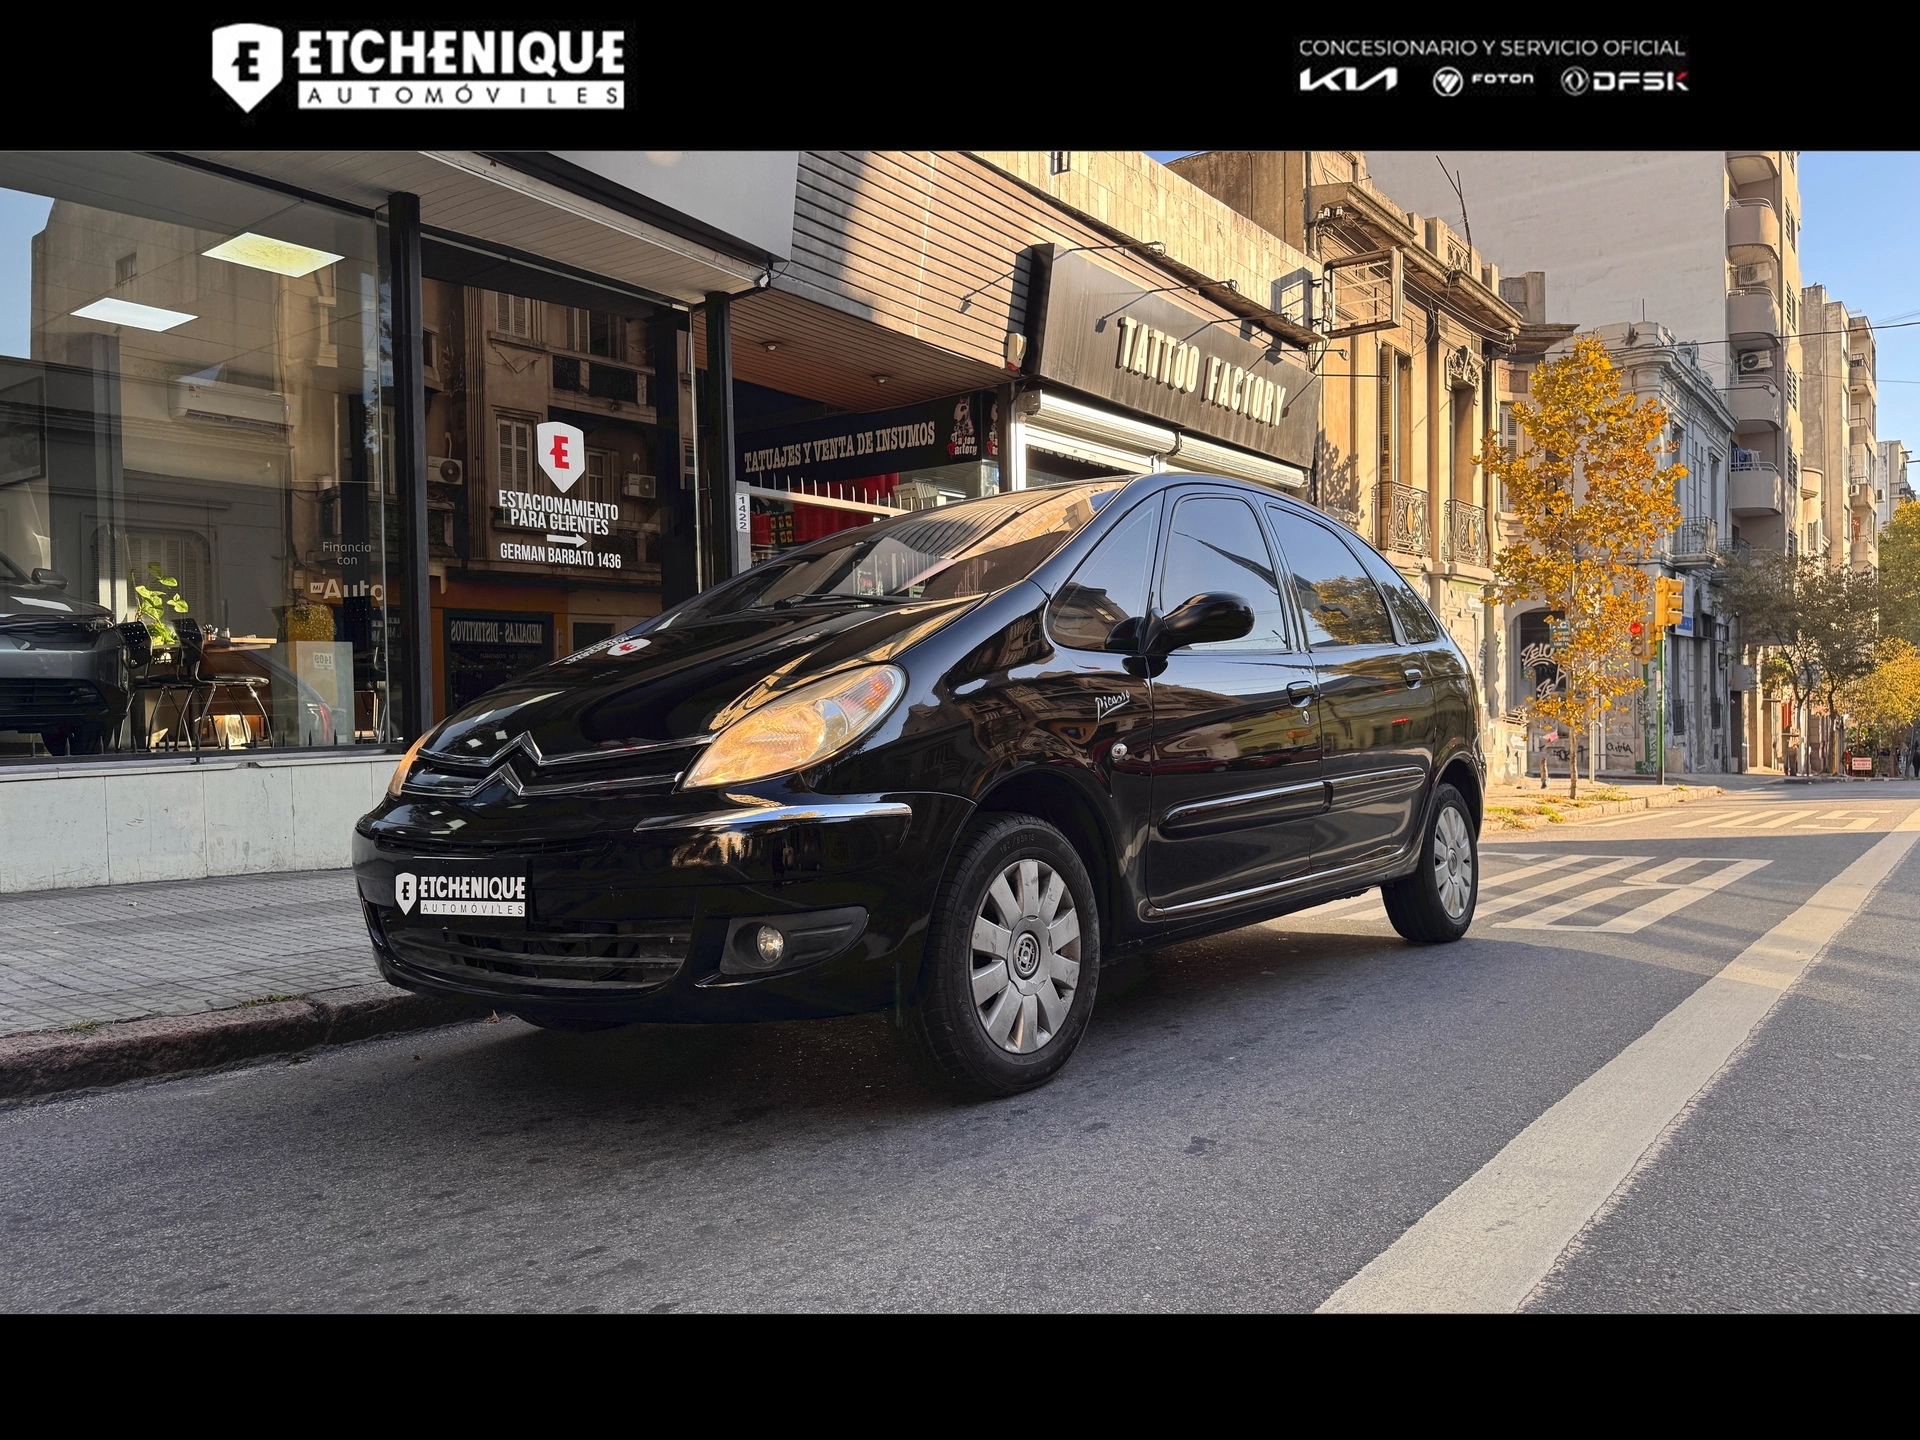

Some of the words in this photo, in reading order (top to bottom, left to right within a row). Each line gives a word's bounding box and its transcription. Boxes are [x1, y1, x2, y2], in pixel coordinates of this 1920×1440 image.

[1119, 316, 1200, 393] TATTOO
[1204, 356, 1287, 427] FACTORY
[744, 443, 801, 473] TATUAJES
[803, 442, 812, 464] Y
[813, 434, 855, 463] VENTA
[857, 431, 874, 455] DE
[875, 421, 936, 452] INSUMOS
[498, 489, 619, 521] ESTACIONAMIENTO
[738, 496, 748, 530] 1422
[510, 508, 547, 529] PARA
[549, 513, 609, 536] CLIENTES
[322, 541, 372, 553] Financia
[336, 556, 358, 565] con
[500, 542, 545, 562] GERMAN
[548, 547, 594, 567] BARBATO
[597, 552, 622, 569] 1436
[323, 578, 384, 601] Auto
[1094, 689, 1131, 723] Picasso
[418, 876, 526, 900] ETCHENIQUE
[422, 903, 524, 915] AUTOMÓVILES
